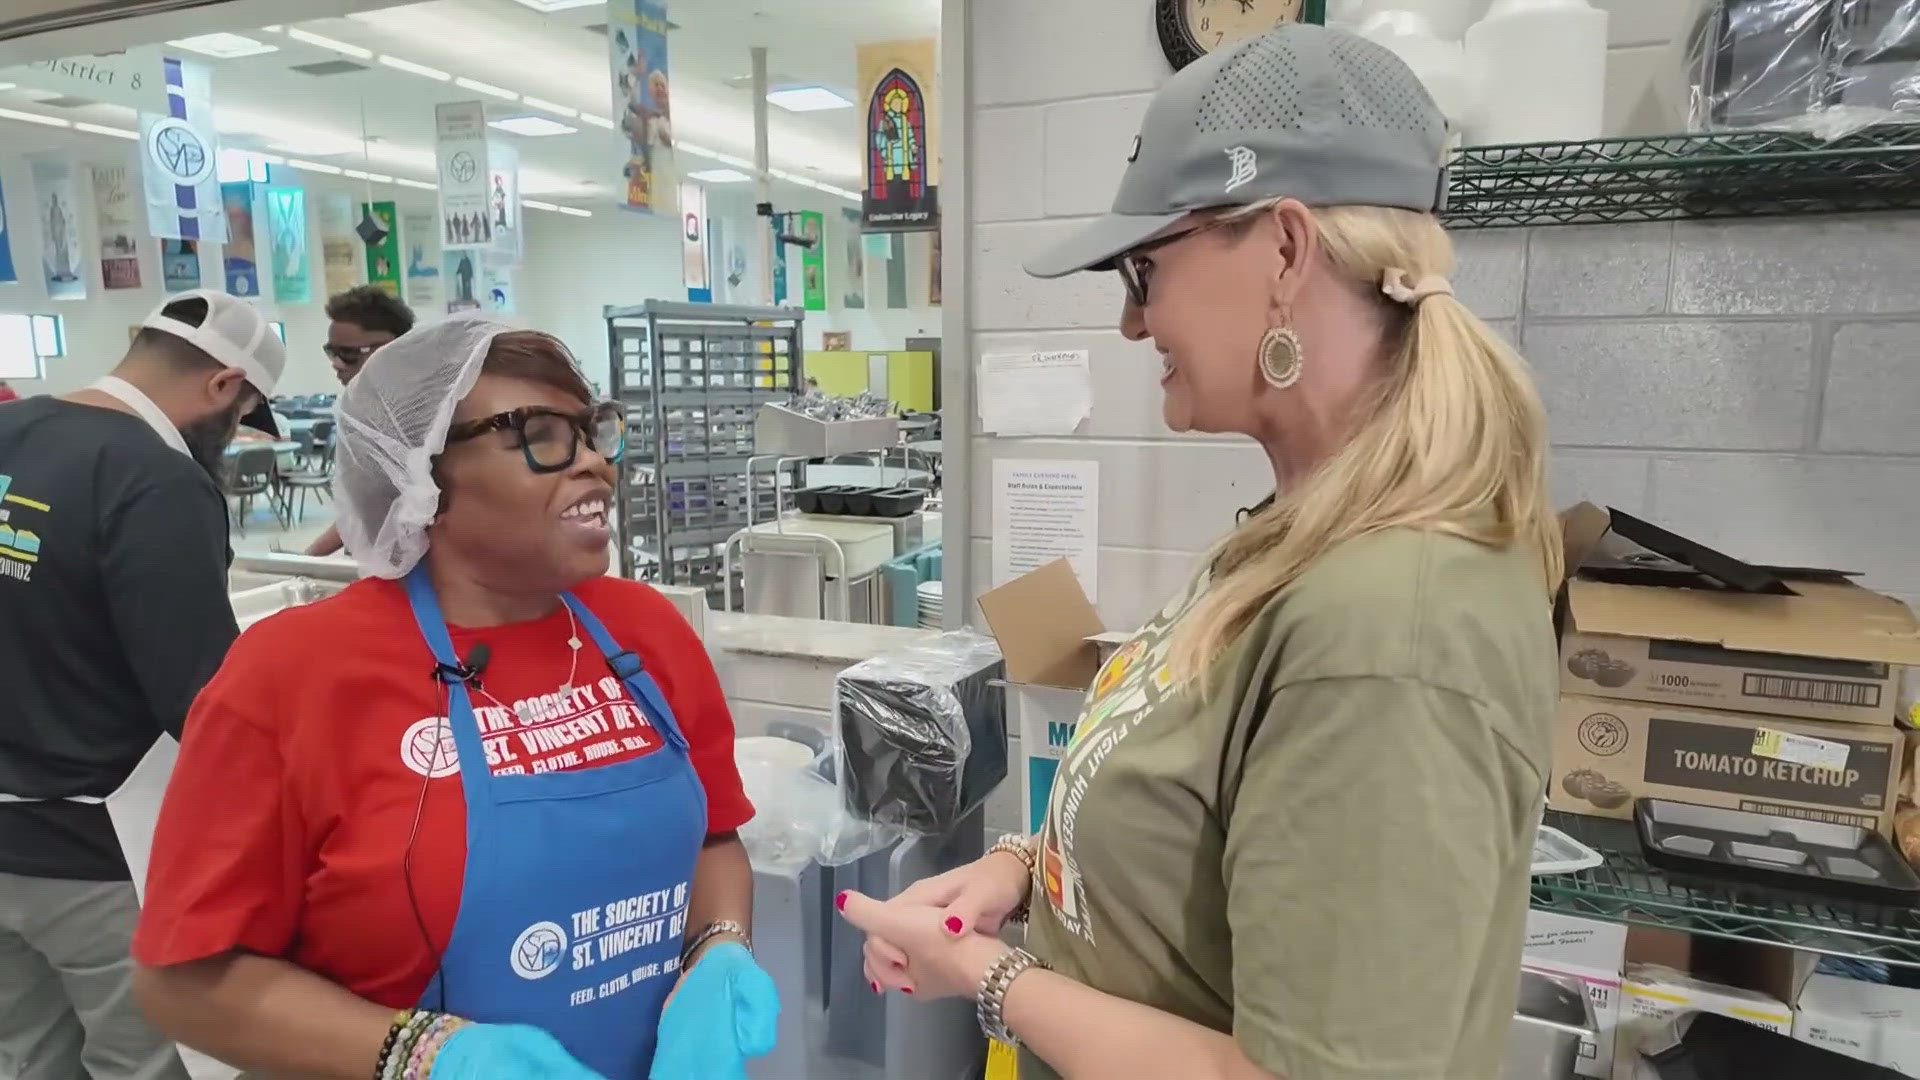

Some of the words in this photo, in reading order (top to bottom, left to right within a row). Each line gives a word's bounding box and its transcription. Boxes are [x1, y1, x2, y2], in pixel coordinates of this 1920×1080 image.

[1200, 17, 1210, 32] 8
[1215, 32, 1224, 47] 7
[130, 72, 142, 90] 8
[1044, 483, 1083, 491] Expectations
[1661, 674, 1690, 688] 1000
[473, 706, 514, 733] THE
[513, 683, 599, 726] SOCIETY
[598, 676, 622, 701] OF
[483, 735, 518, 766] ST.
[518, 709, 610, 756] VINCENT
[610, 704, 634, 730] DE
[1087, 723, 1129, 778] FIGHT
[1674, 749, 1758, 777] TOMATO
[1762, 759, 1860, 788] KETCHUP
[1062, 773, 1089, 851] HUNGER
[571, 906, 601, 939] THE
[605, 887, 671, 928] SOCIETY
[674, 881, 688, 908] OF
[572, 940, 595, 971] ST.
[599, 919, 665, 962] VINCENT
[669, 912, 683, 940] DE
[570, 987, 596, 1007] FEED.
[599, 974, 631, 999] CLOTHE.
